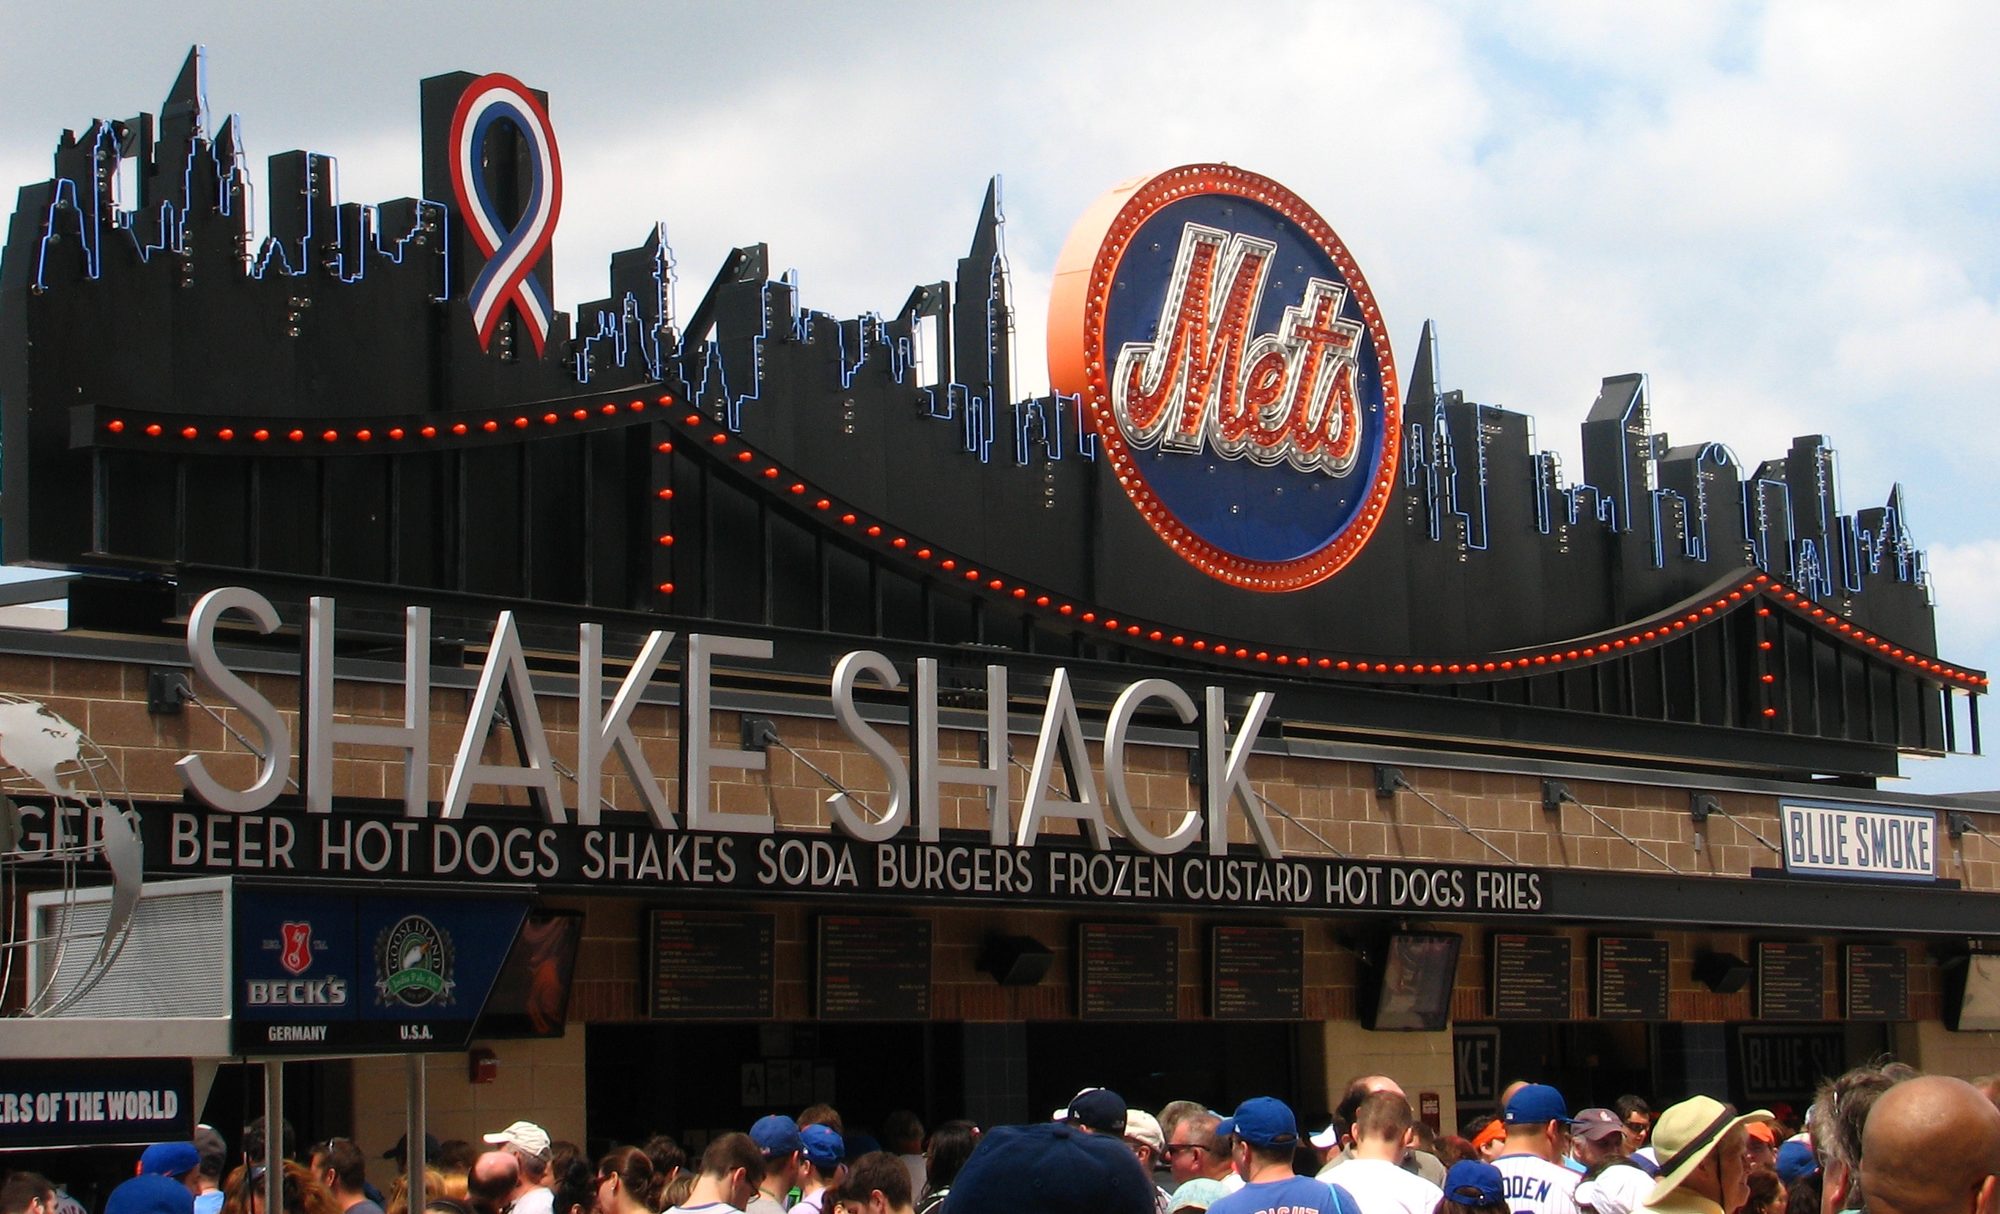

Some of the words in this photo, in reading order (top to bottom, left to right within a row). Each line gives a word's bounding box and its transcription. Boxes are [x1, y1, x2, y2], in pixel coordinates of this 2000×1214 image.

[1111, 221, 1365, 478] Mets
[175, 587, 774, 833] SHAKE
[825, 650, 1284, 859] SHACK
[170, 812, 296, 869] BEER
[321, 819, 419, 872] HOT
[433, 825, 560, 878] DOGS
[581, 830, 737, 883] SHAKES
[756, 839, 859, 887] SODA
[877, 843, 1034, 893] BURGERS
[1049, 852, 1174, 898] FROZEN
[1183, 858, 1313, 903] CUSTARD
[1325, 864, 1383, 905] HOT
[1390, 867, 1465, 908] DOGS
[1476, 872, 1542, 911] FRIES
[1790, 811, 1849, 866] BLUE
[1855, 816, 1930, 871] SMOKE
[247, 975, 348, 1007] BECK'S
[268, 1025, 328, 1042] GERMANY
[400, 1024, 434, 1041] U.S.A.
[1748, 1037, 1806, 1089] BLUE
[36, 1091, 61, 1123] OF
[64, 1091, 105, 1122] THE
[107, 1089, 178, 1121] WORLD
